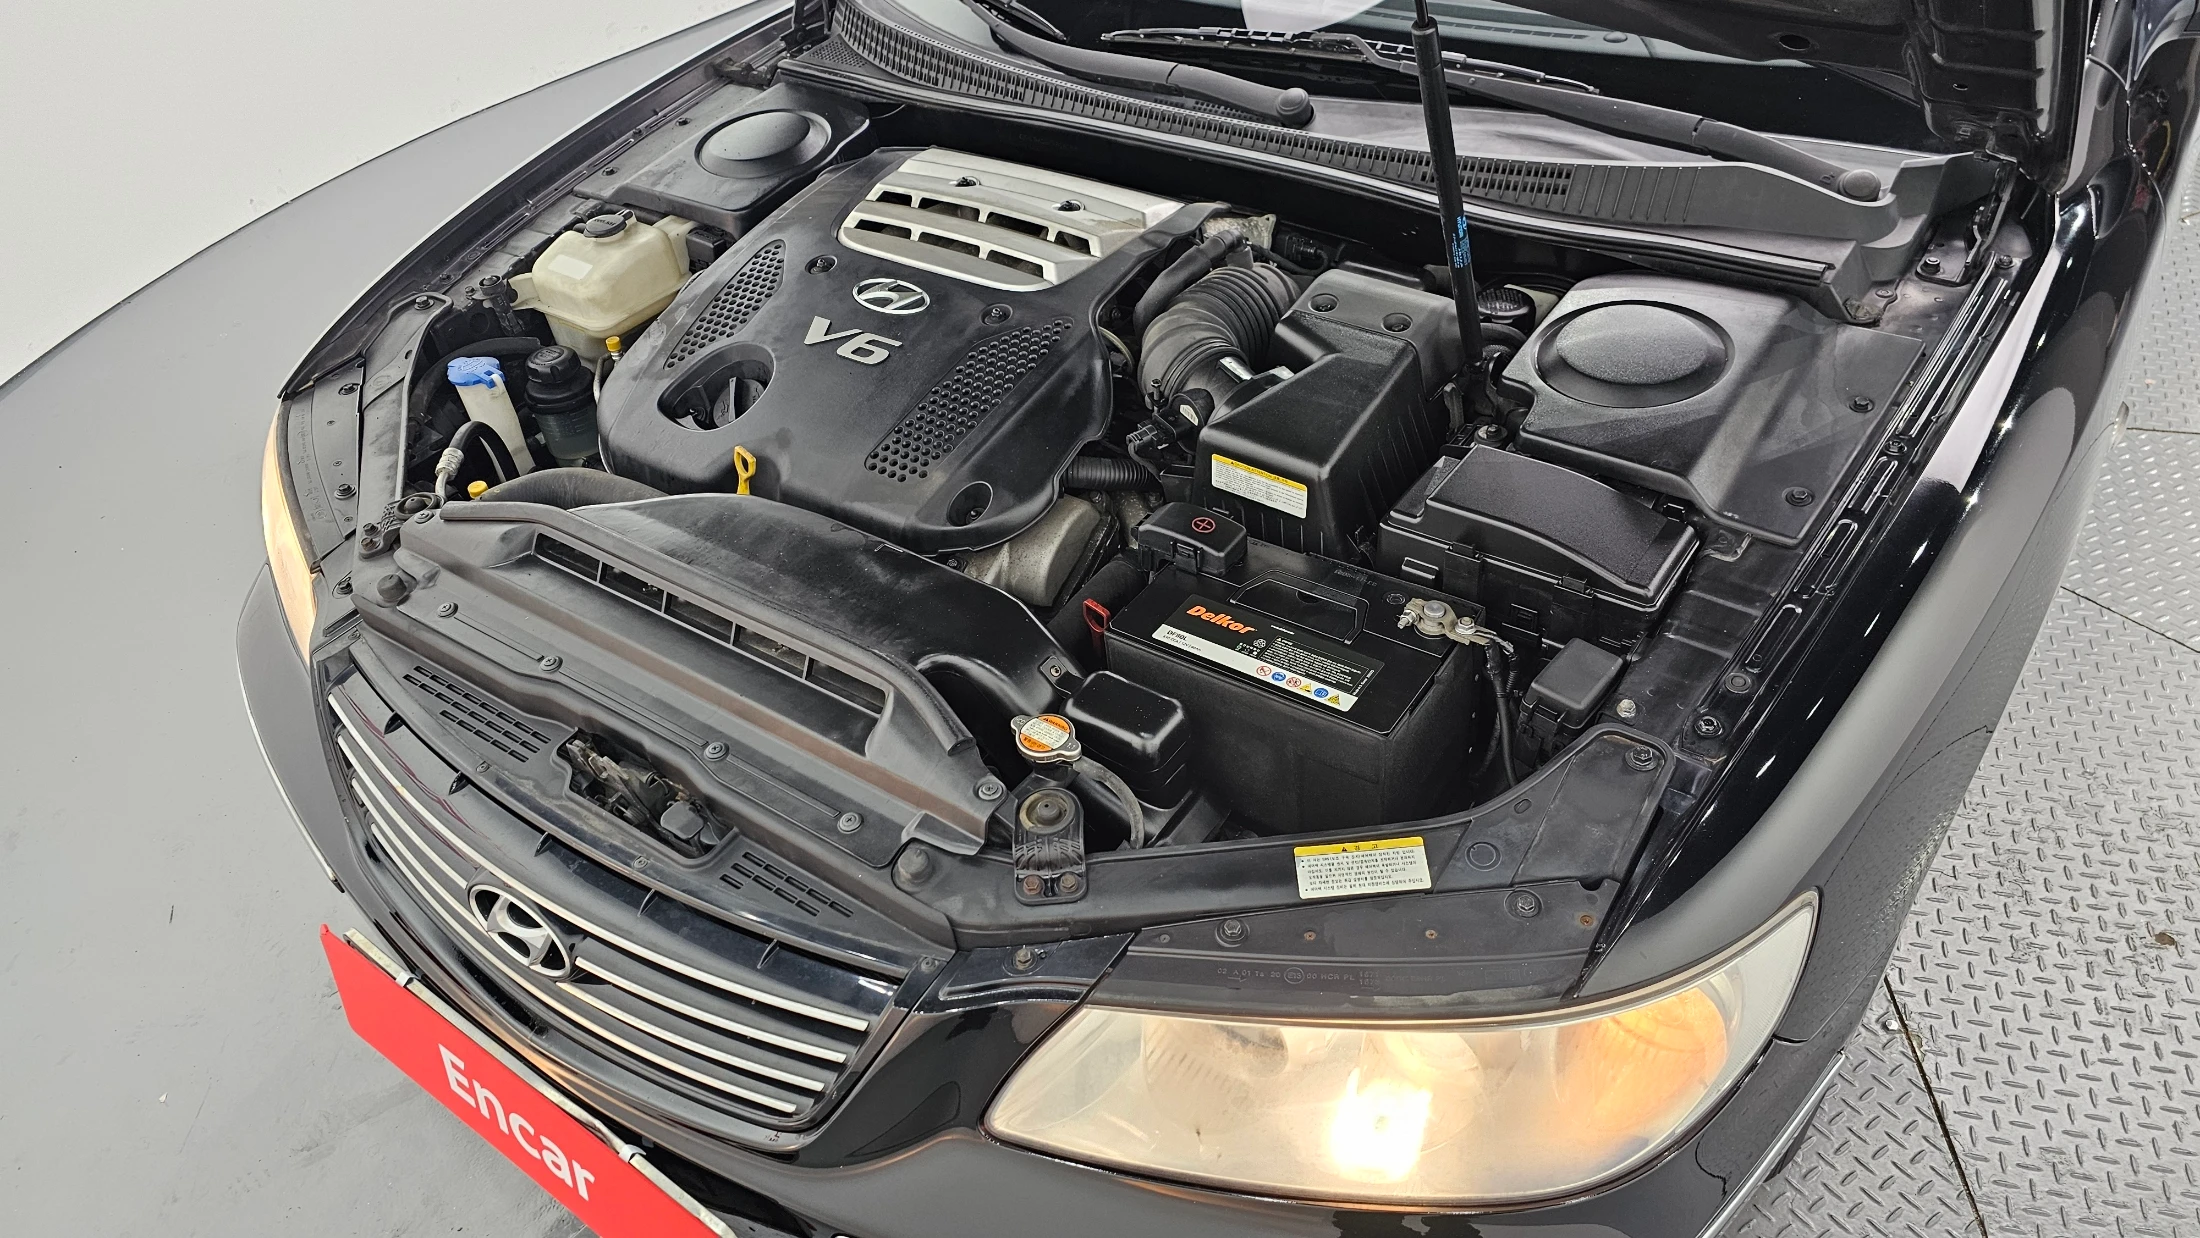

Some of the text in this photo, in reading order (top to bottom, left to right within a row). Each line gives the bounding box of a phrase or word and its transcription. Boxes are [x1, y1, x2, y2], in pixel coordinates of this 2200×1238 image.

[804, 315, 903, 365] V6
[1186, 605, 1256, 634] Delkor
[438, 1043, 596, 1201] Encar
